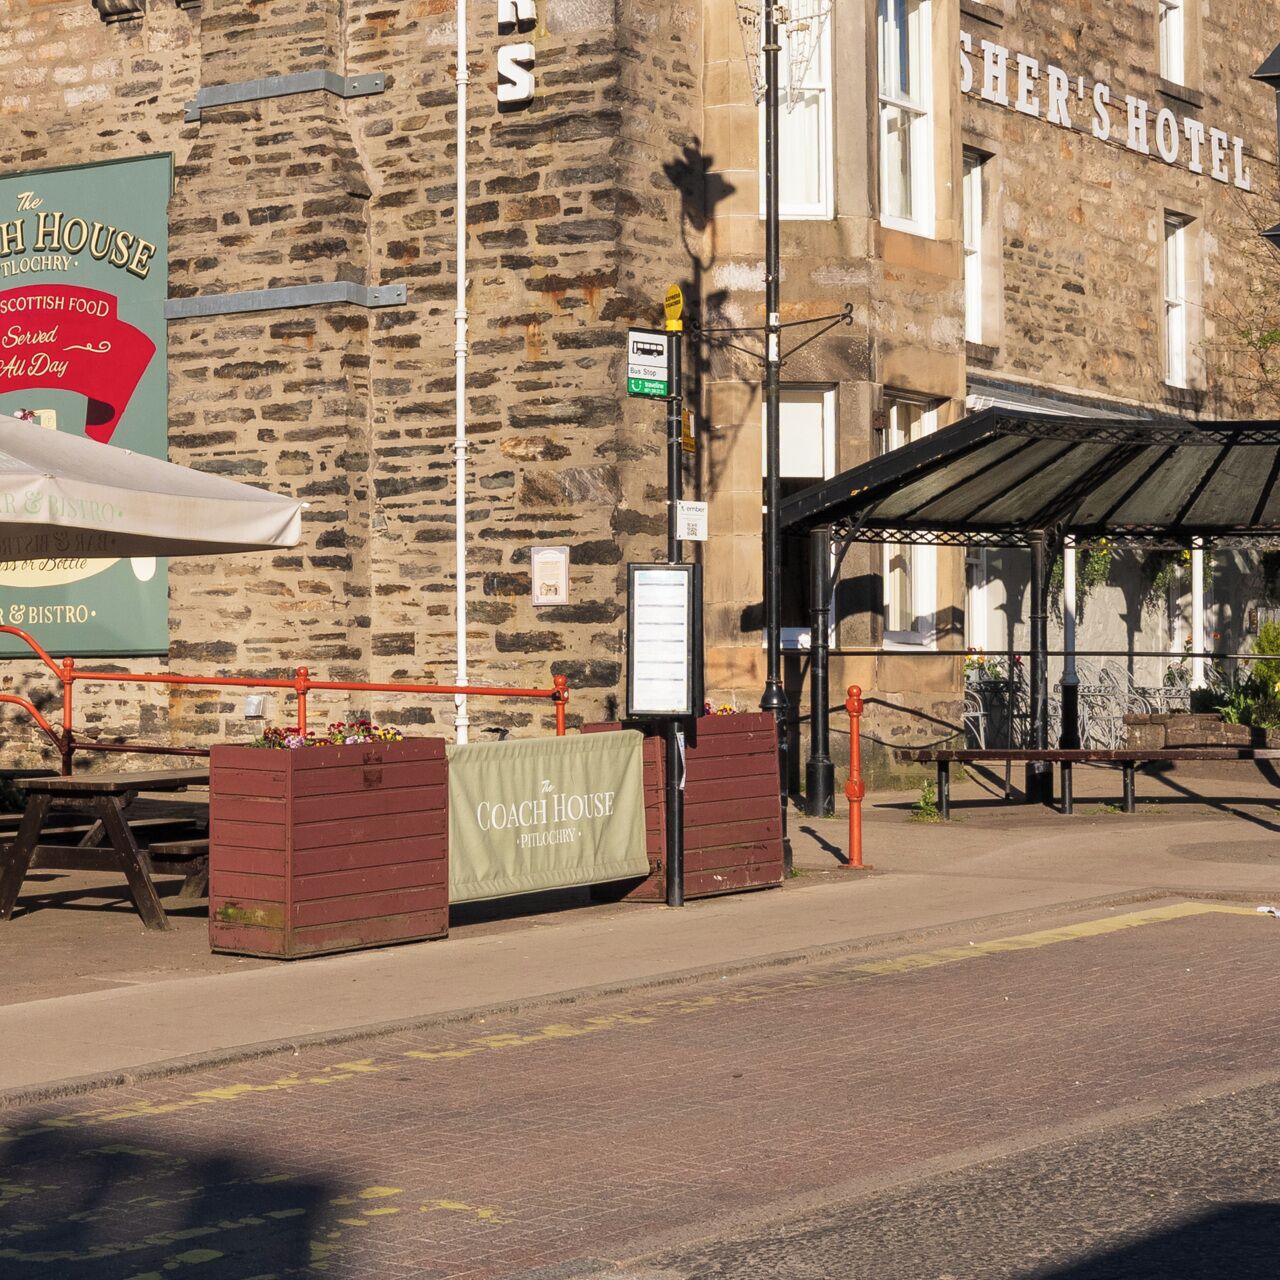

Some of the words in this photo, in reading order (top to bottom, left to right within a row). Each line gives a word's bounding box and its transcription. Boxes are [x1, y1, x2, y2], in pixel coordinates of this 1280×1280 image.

[1126, 95, 1250, 191] HOTEL
[17, 192, 43, 212] The
[34, 212, 157, 279] HOUSE
[0, 296, 65, 314] SCOTTISH
[68, 297, 110, 317] FOOD
[1, 325, 59, 348] Served
[27, 352, 69, 378] Day
[630, 367, 641, 375] Bus
[643, 368, 657, 377] Stop
[24, 491, 42, 514] &
[48, 493, 115, 521] BISTRO
[9, 605, 25, 625] &
[29, 605, 88, 624] BISTRO
[541, 779, 556, 793] The
[477, 799, 547, 831] COACH
[553, 791, 615, 822] HOUSE
[521, 827, 576, 848] PITLOCHRY
